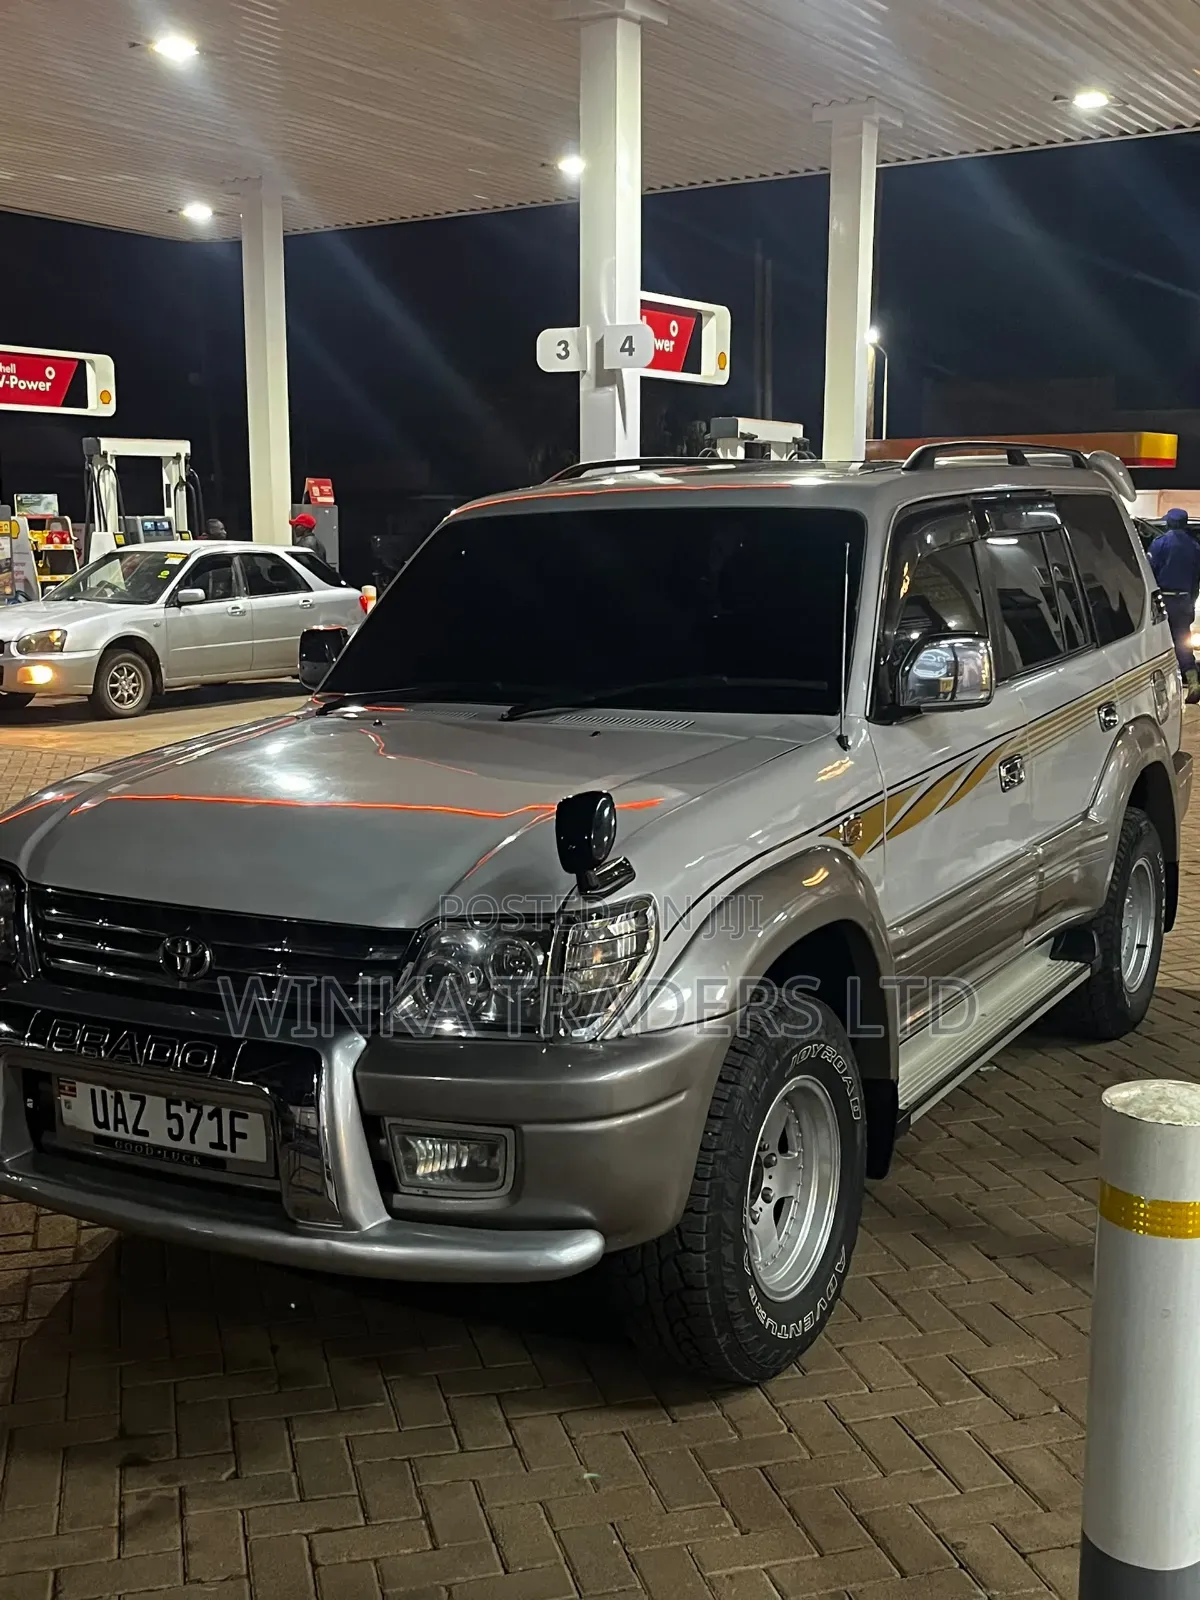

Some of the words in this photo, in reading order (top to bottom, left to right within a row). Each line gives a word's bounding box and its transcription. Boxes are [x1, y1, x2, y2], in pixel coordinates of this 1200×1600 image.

[556, 340, 570, 360] 3
[619, 335, 635, 356] 4
[654, 338, 675, 352] wer
[0, 362, 16, 374] hell
[46, 1018, 219, 1077] PRADO
[785, 1042, 861, 1120] JOYROAD
[90, 1087, 150, 1138] UAZ
[165, 1099, 249, 1154] 571F
[114, 1139, 154, 1156] GOOD
[163, 1150, 201, 1166] LUCK
[749, 1244, 846, 1340] ADVENTURE
